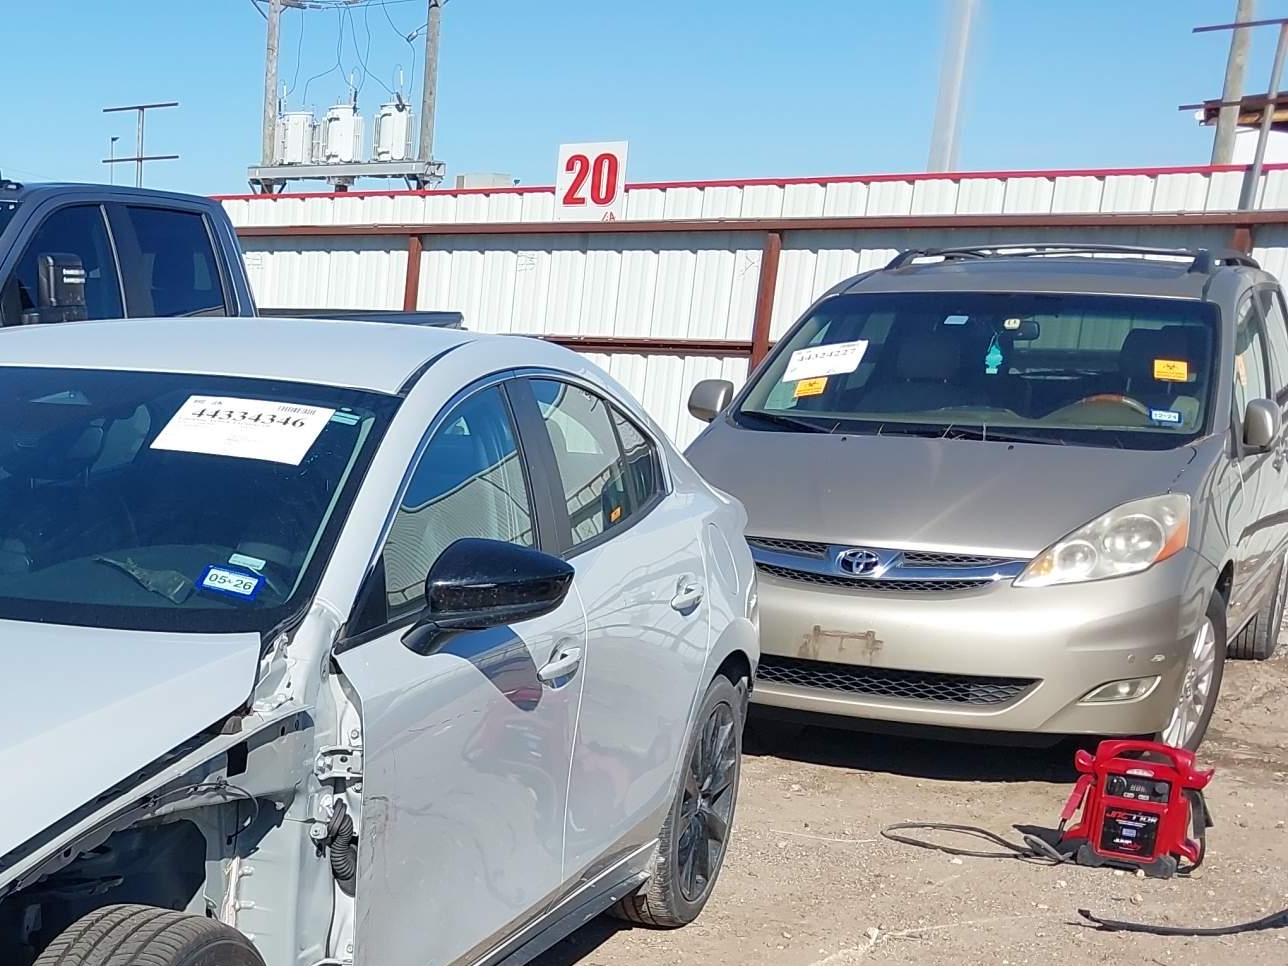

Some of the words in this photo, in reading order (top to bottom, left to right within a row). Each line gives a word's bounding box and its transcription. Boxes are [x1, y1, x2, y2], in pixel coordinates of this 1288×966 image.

[562, 153, 618, 205] 20
[192, 408, 305, 428] 44334346
[208, 573, 253, 590] 05-26
